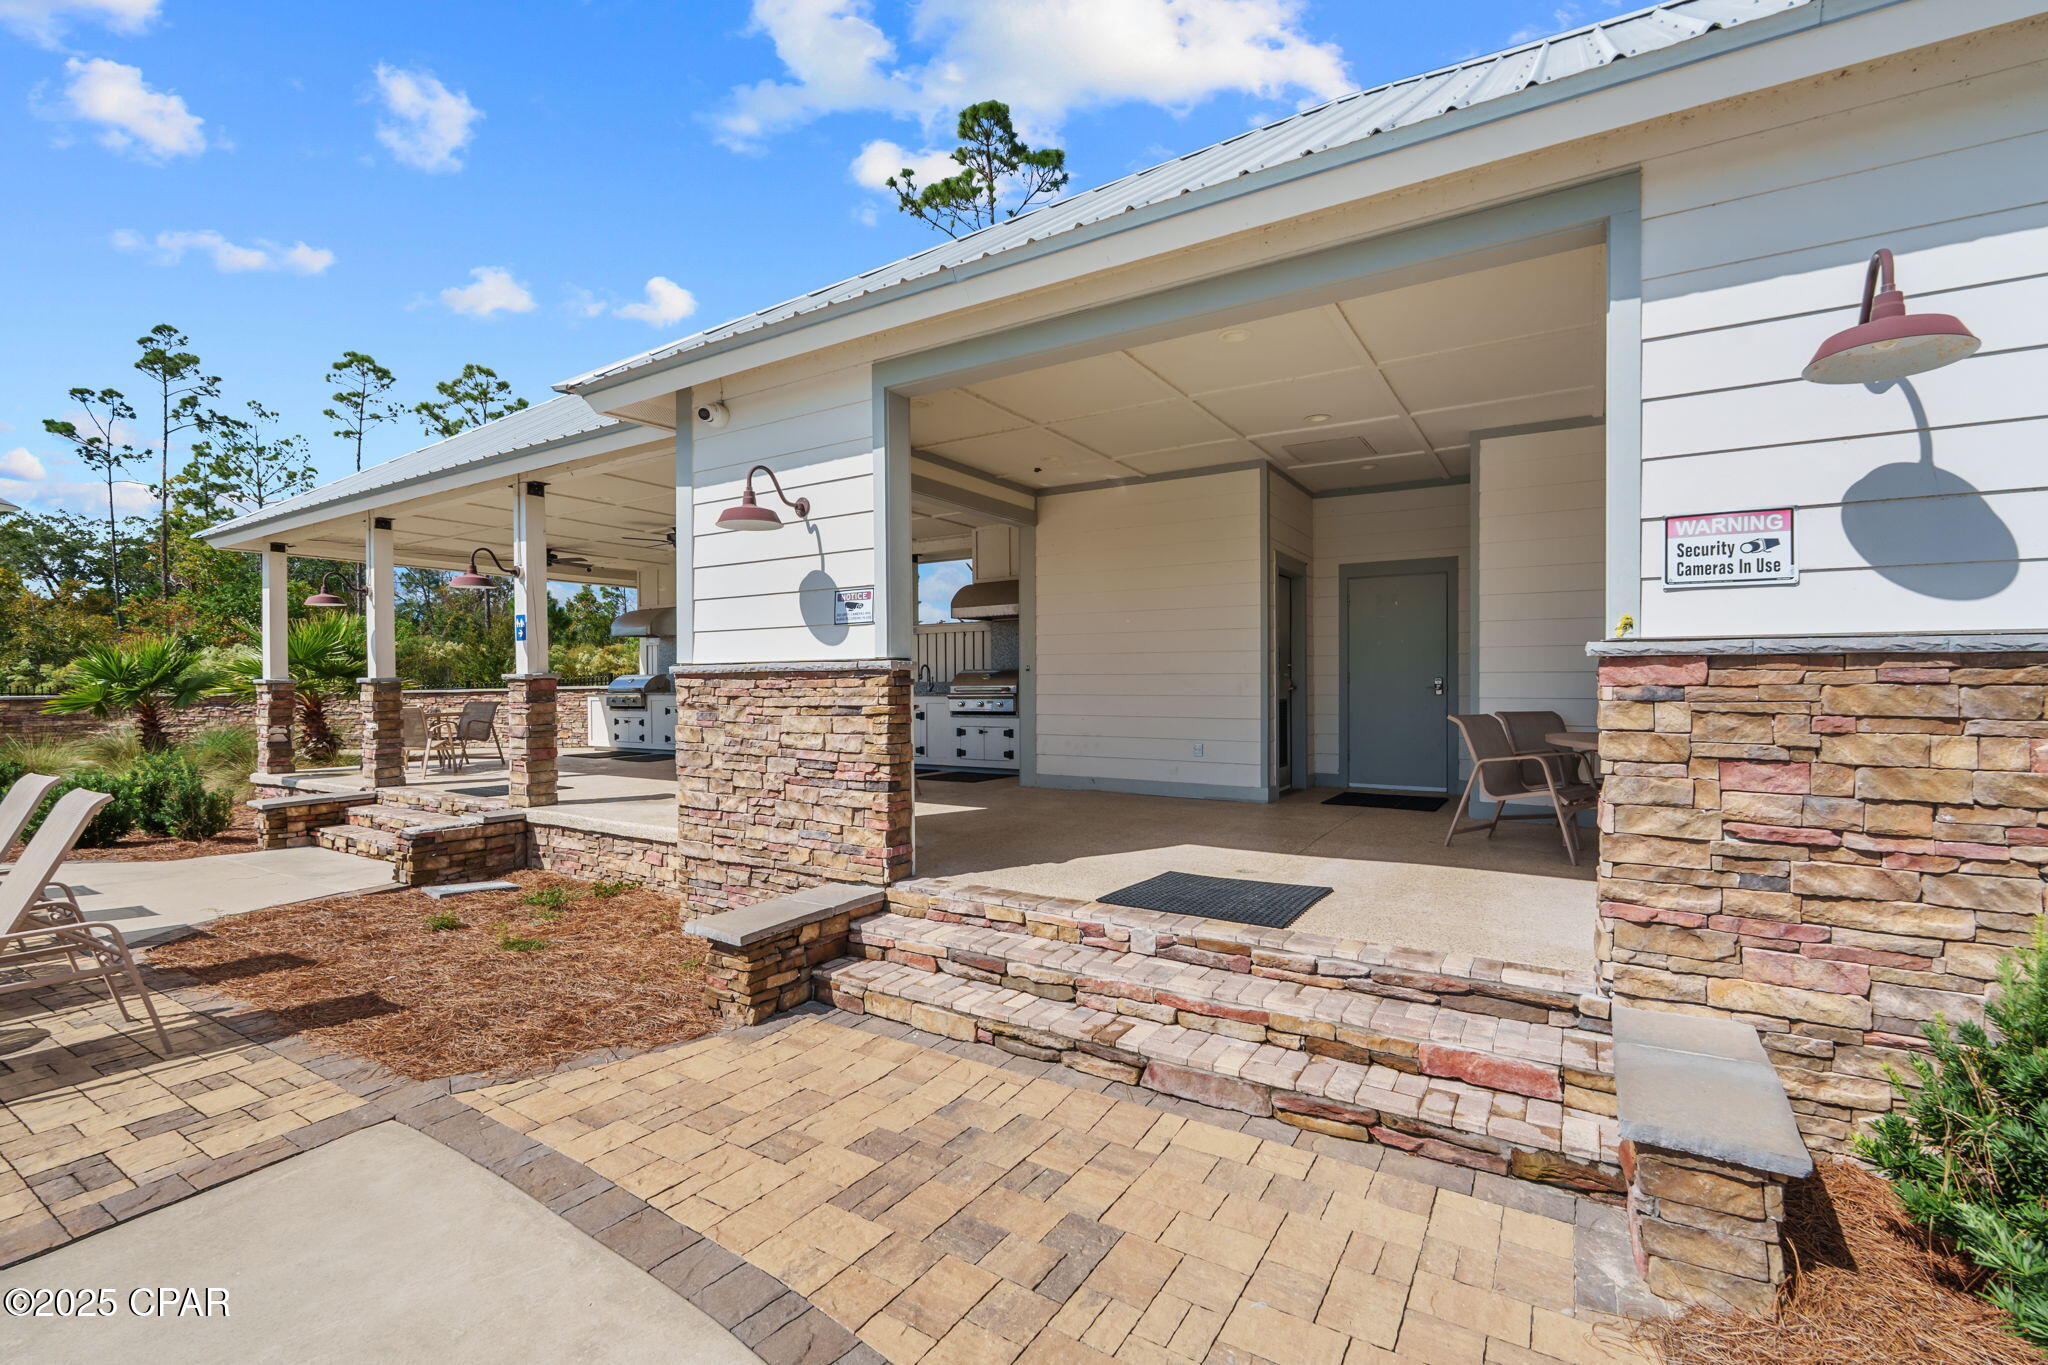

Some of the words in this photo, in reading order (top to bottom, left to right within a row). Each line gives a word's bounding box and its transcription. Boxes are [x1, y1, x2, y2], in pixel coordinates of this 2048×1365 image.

[1675, 514, 1783, 536] WARNING
[1677, 541, 1735, 558] Security
[1676, 562, 1734, 577] Cameras
[1739, 559, 1752, 574] In
[1756, 558, 1781, 573] Use
[841, 592, 867, 601] NOTICE
